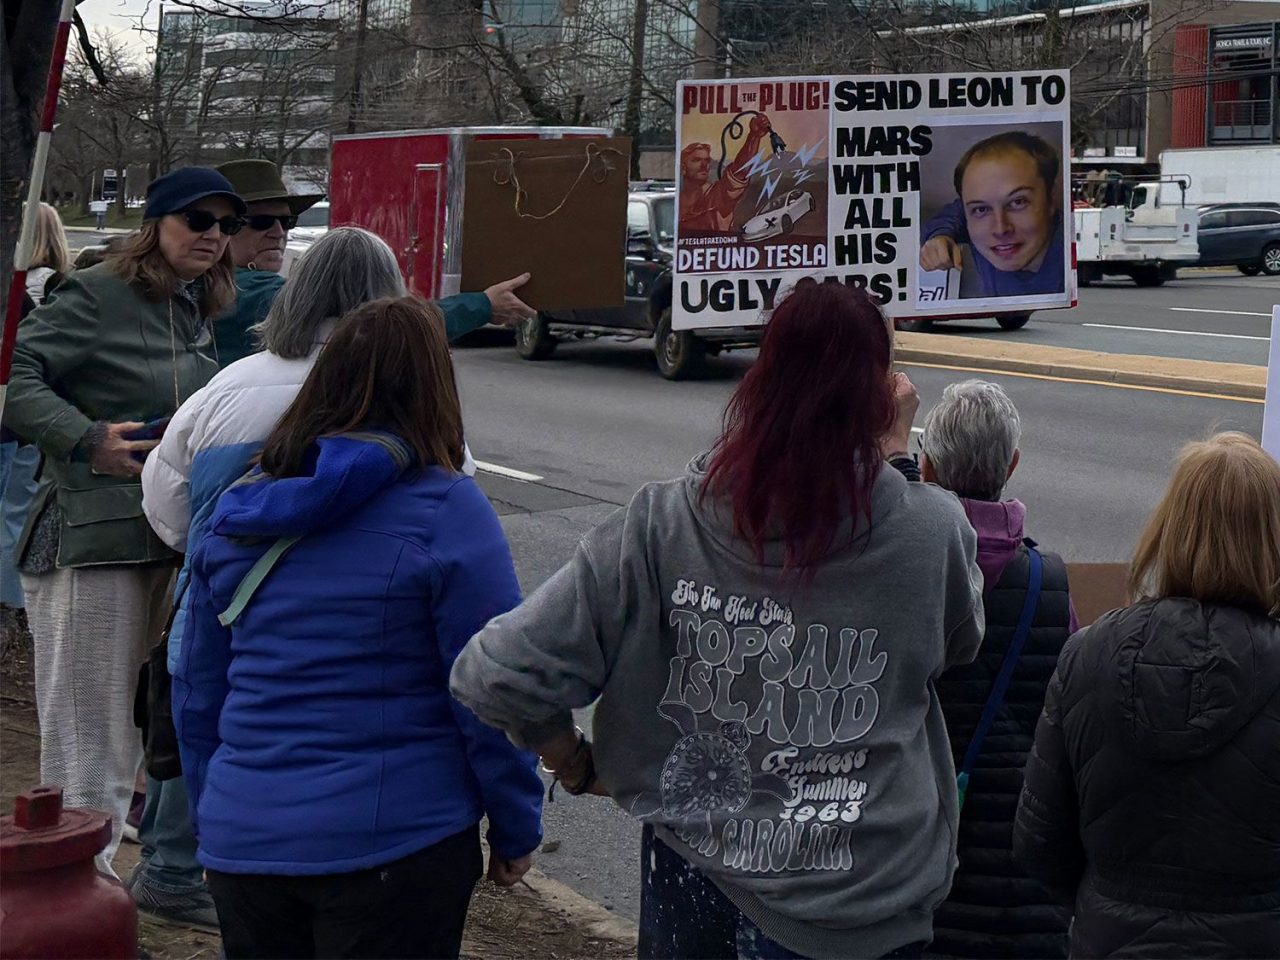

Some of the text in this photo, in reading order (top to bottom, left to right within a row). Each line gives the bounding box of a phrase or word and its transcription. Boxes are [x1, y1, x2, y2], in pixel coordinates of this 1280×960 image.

[683, 81, 830, 114] PULL THE PLUG!
[834, 74, 1066, 112] SEND LEON TO
[836, 124, 933, 158] MARS
[833, 160, 921, 196] WITH
[844, 197, 911, 230] ALL
[678, 243, 827, 272] DEFUND TESLA
[834, 232, 898, 266] HIS
[681, 277, 782, 314] UGLY
[671, 579, 700, 606] The
[724, 595, 758, 625] Heel
[670, 609, 888, 690] TOPSAIL
[663, 656, 879, 747] ISLAND
[783, 775, 868, 807] Summer
[722, 818, 853, 873] CAROLINA
